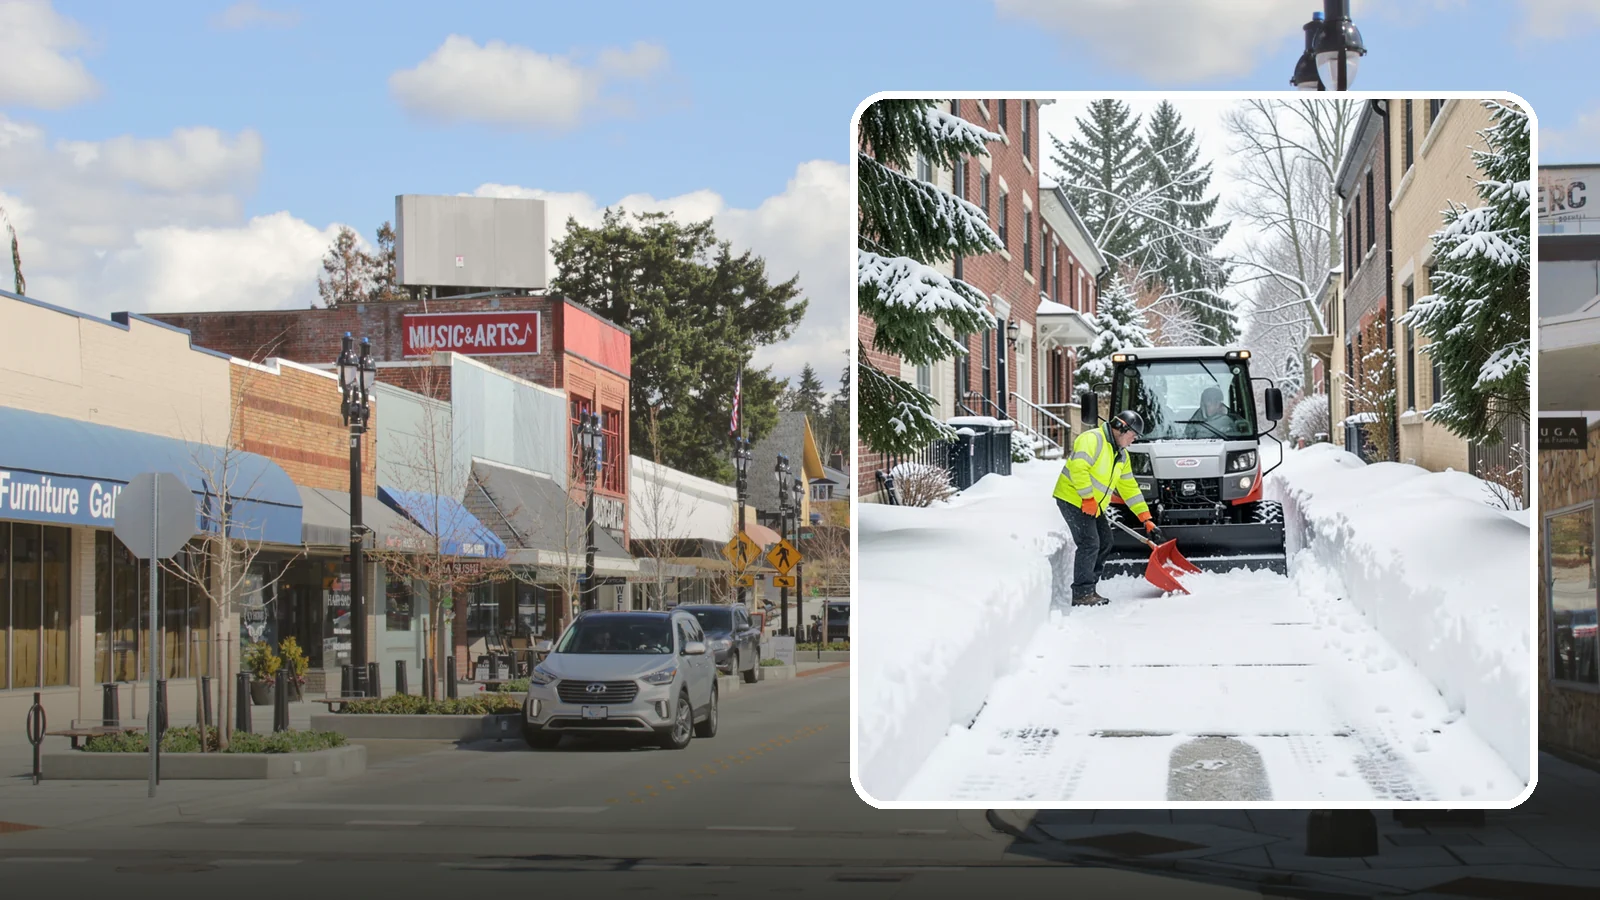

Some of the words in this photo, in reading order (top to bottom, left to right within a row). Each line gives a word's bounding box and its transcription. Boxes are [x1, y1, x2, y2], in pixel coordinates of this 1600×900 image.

[409, 323, 519, 349] MUSIC&ARTS
[0, 471, 79, 515] Furniture
[90, 482, 122, 519] Gal
[454, 563, 479, 573] SUSHI
